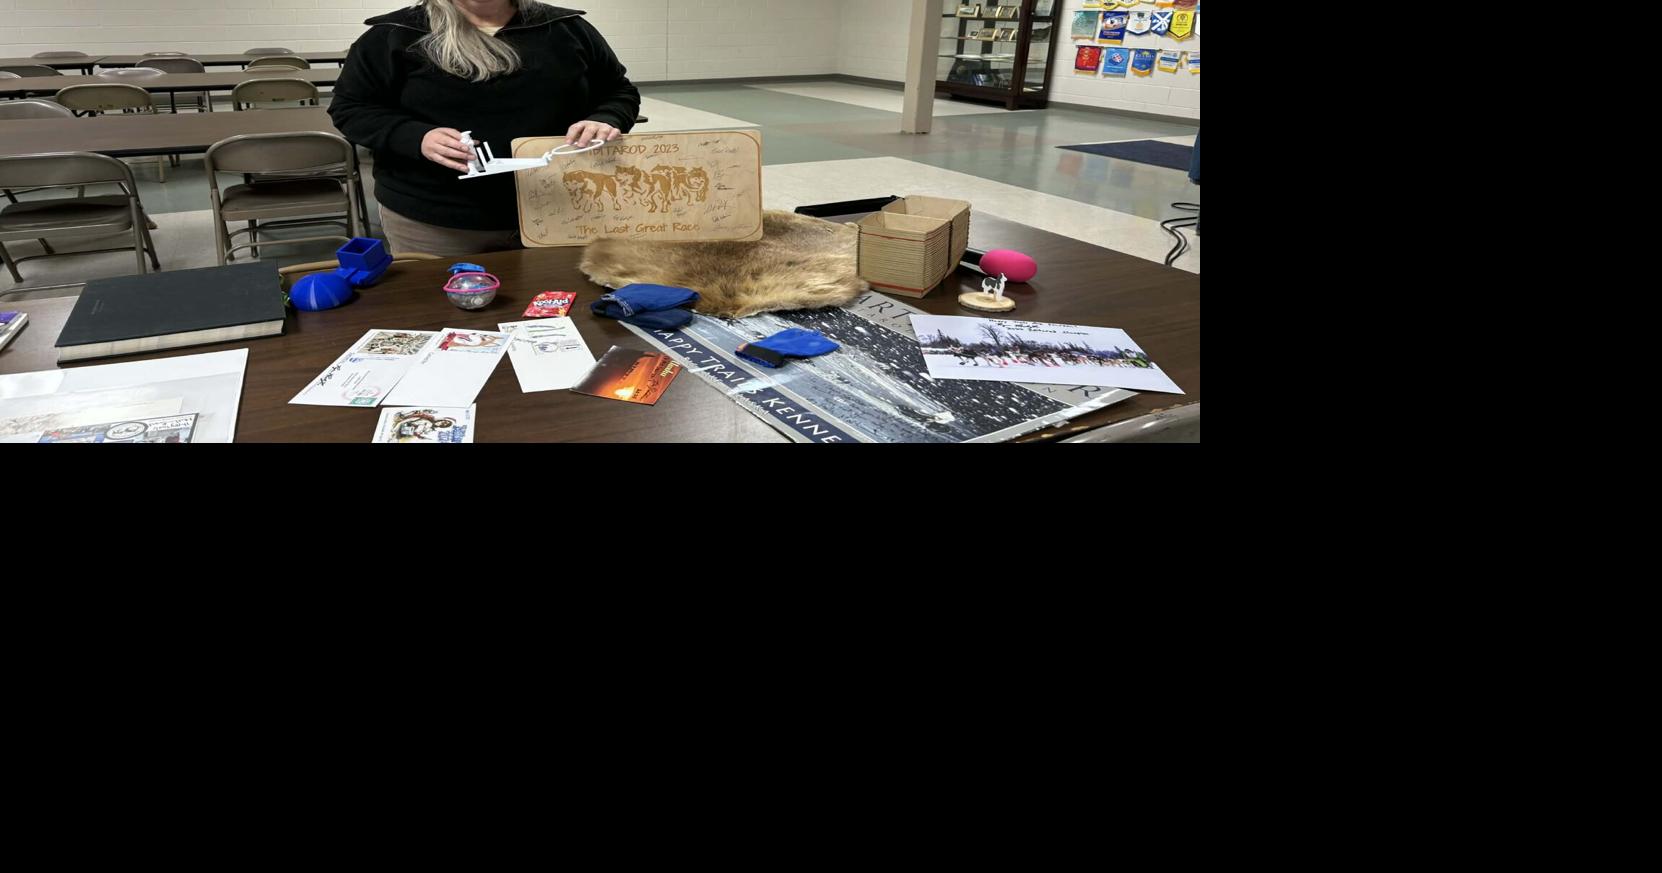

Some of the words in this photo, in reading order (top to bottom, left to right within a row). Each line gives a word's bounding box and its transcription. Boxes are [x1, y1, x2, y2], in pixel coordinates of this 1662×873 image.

[653, 143, 680, 154] 2023
[575, 223, 598, 235] The
[604, 223, 630, 234] Last
[635, 223, 668, 233] Great
[672, 222, 701, 232] Race
[653, 329, 703, 354] APPY
[700, 355, 764, 394] TRAIS
